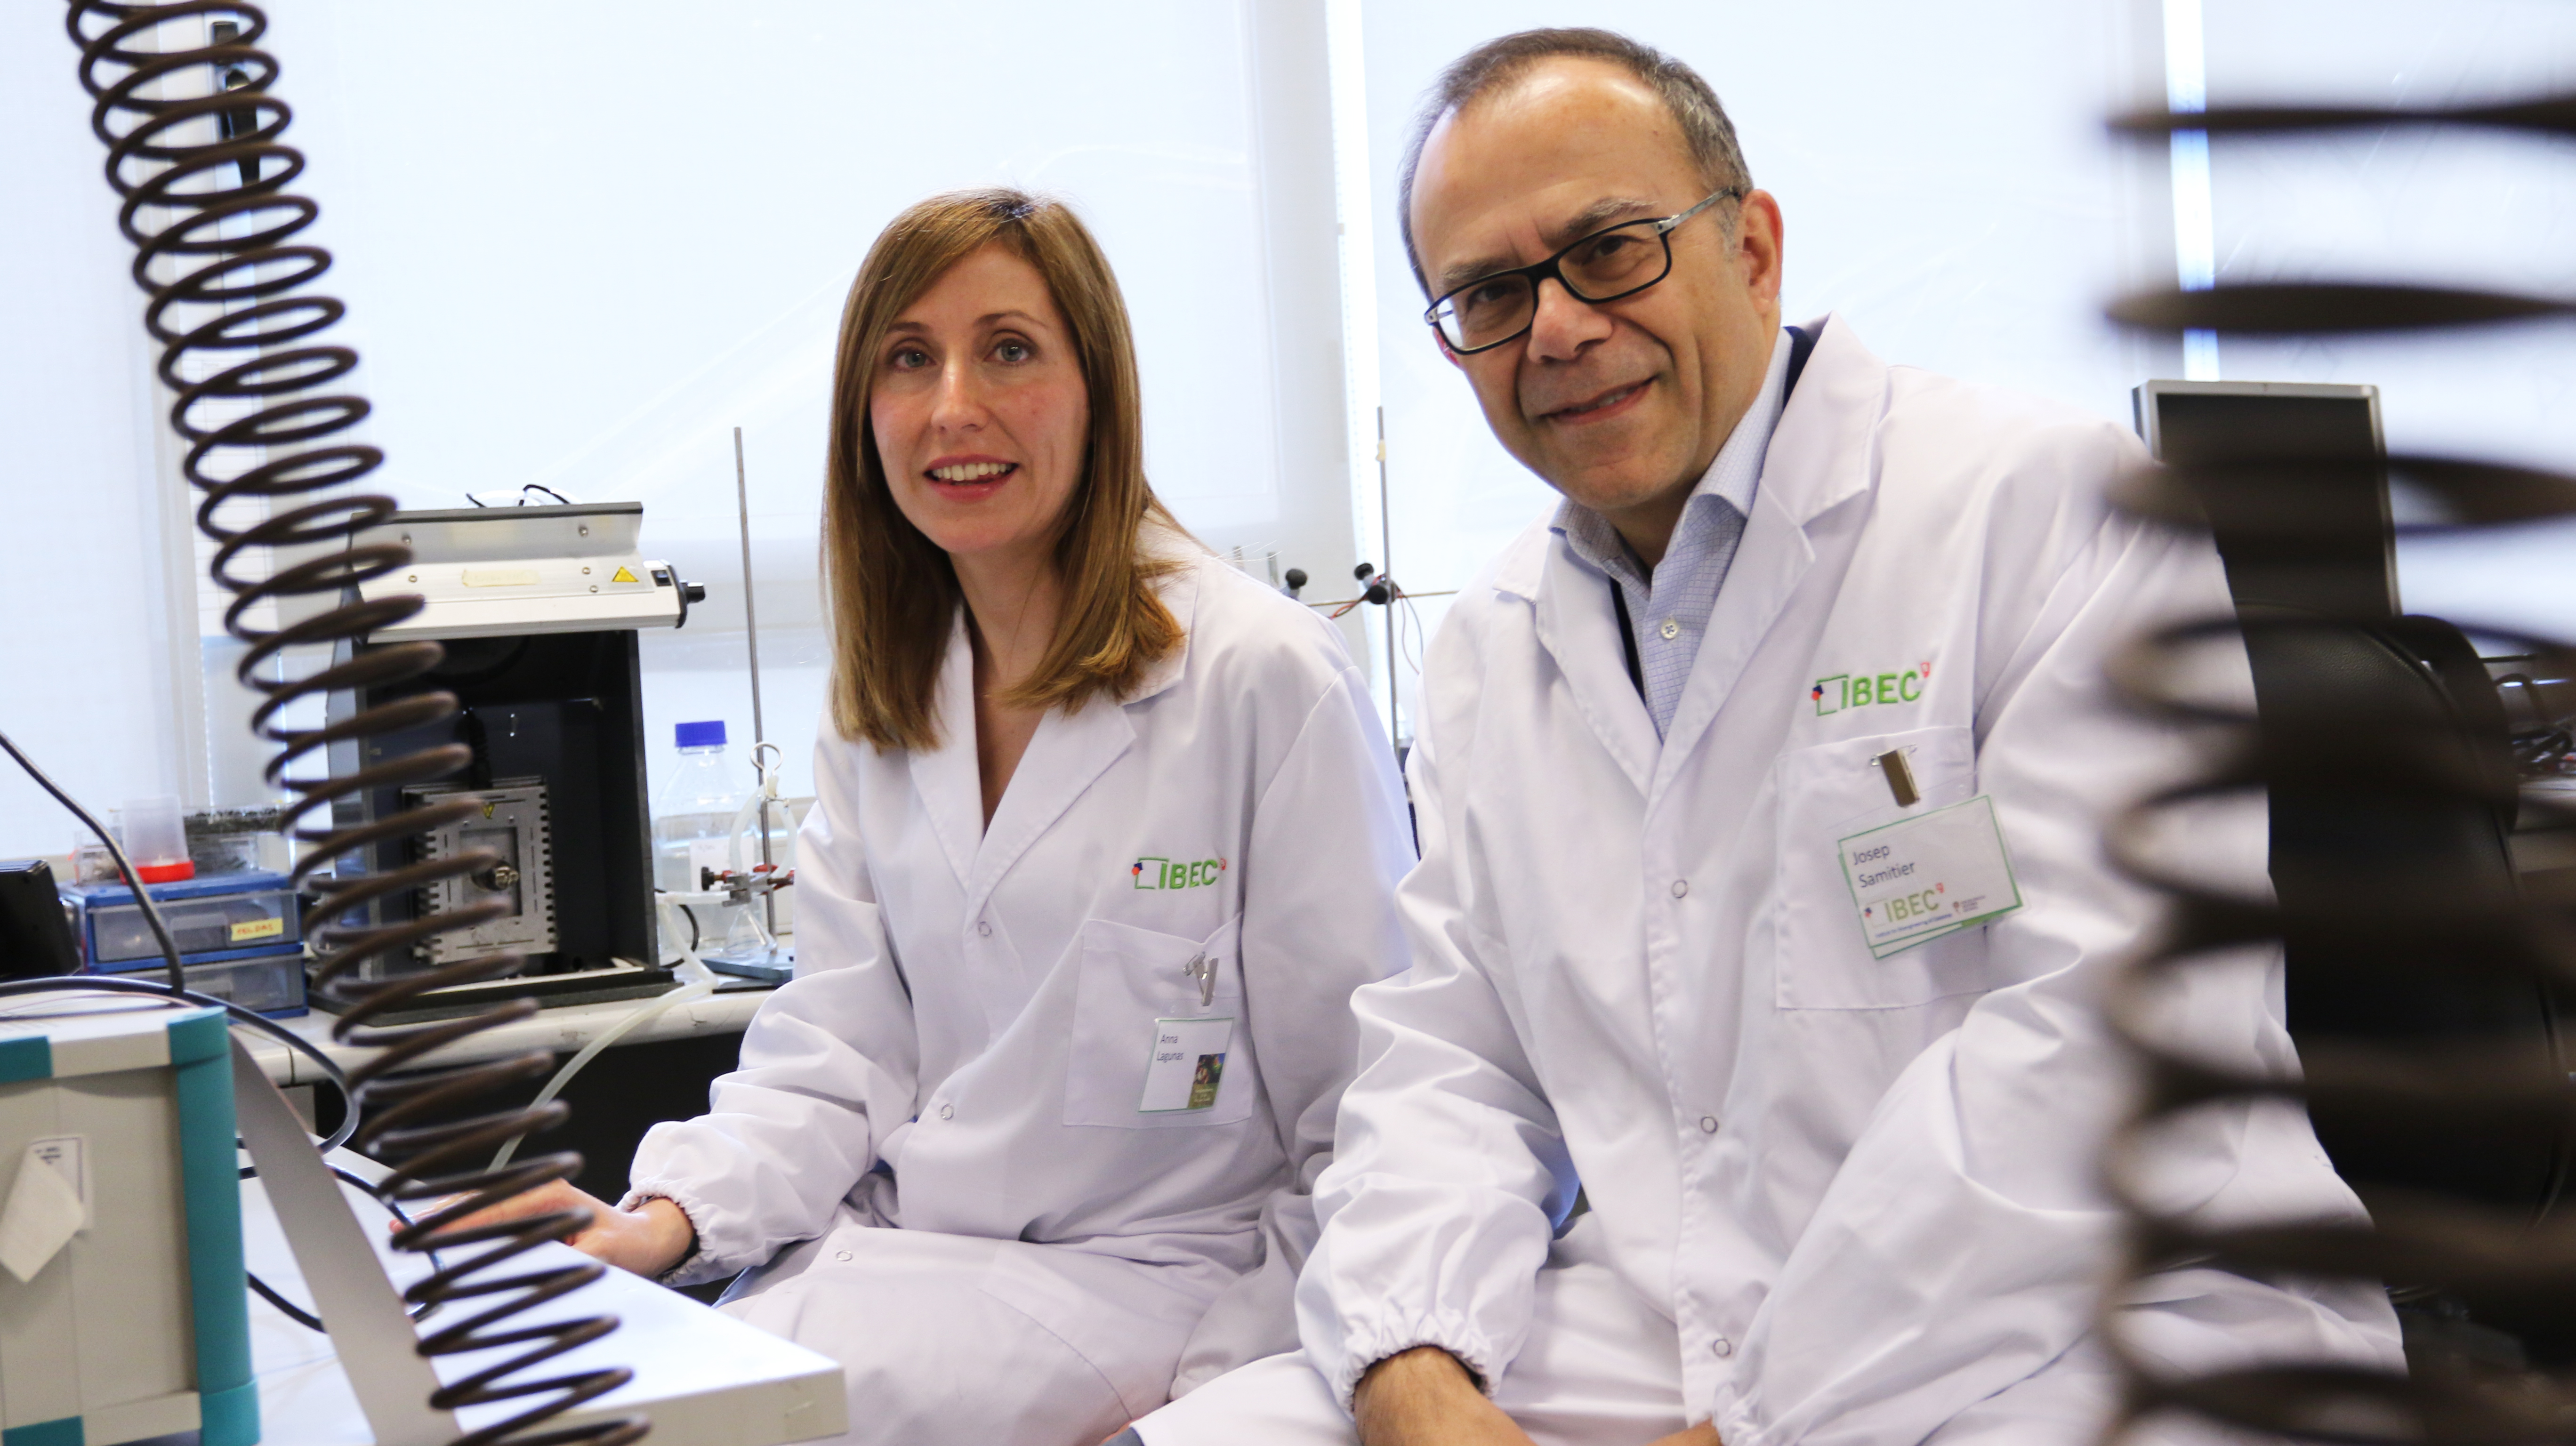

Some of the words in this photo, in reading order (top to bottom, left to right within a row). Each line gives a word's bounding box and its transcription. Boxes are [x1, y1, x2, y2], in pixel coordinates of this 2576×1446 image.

[1841, 671, 1921, 709] IBEC
[1853, 846, 1890, 865] Josep
[1159, 860, 1218, 889] IBEC
[1859, 863, 1915, 888] Samitier
[1884, 890, 1939, 922] IBEC
[1159, 1034, 1178, 1044] Anna
[1157, 1052, 1184, 1063] Lagunas
